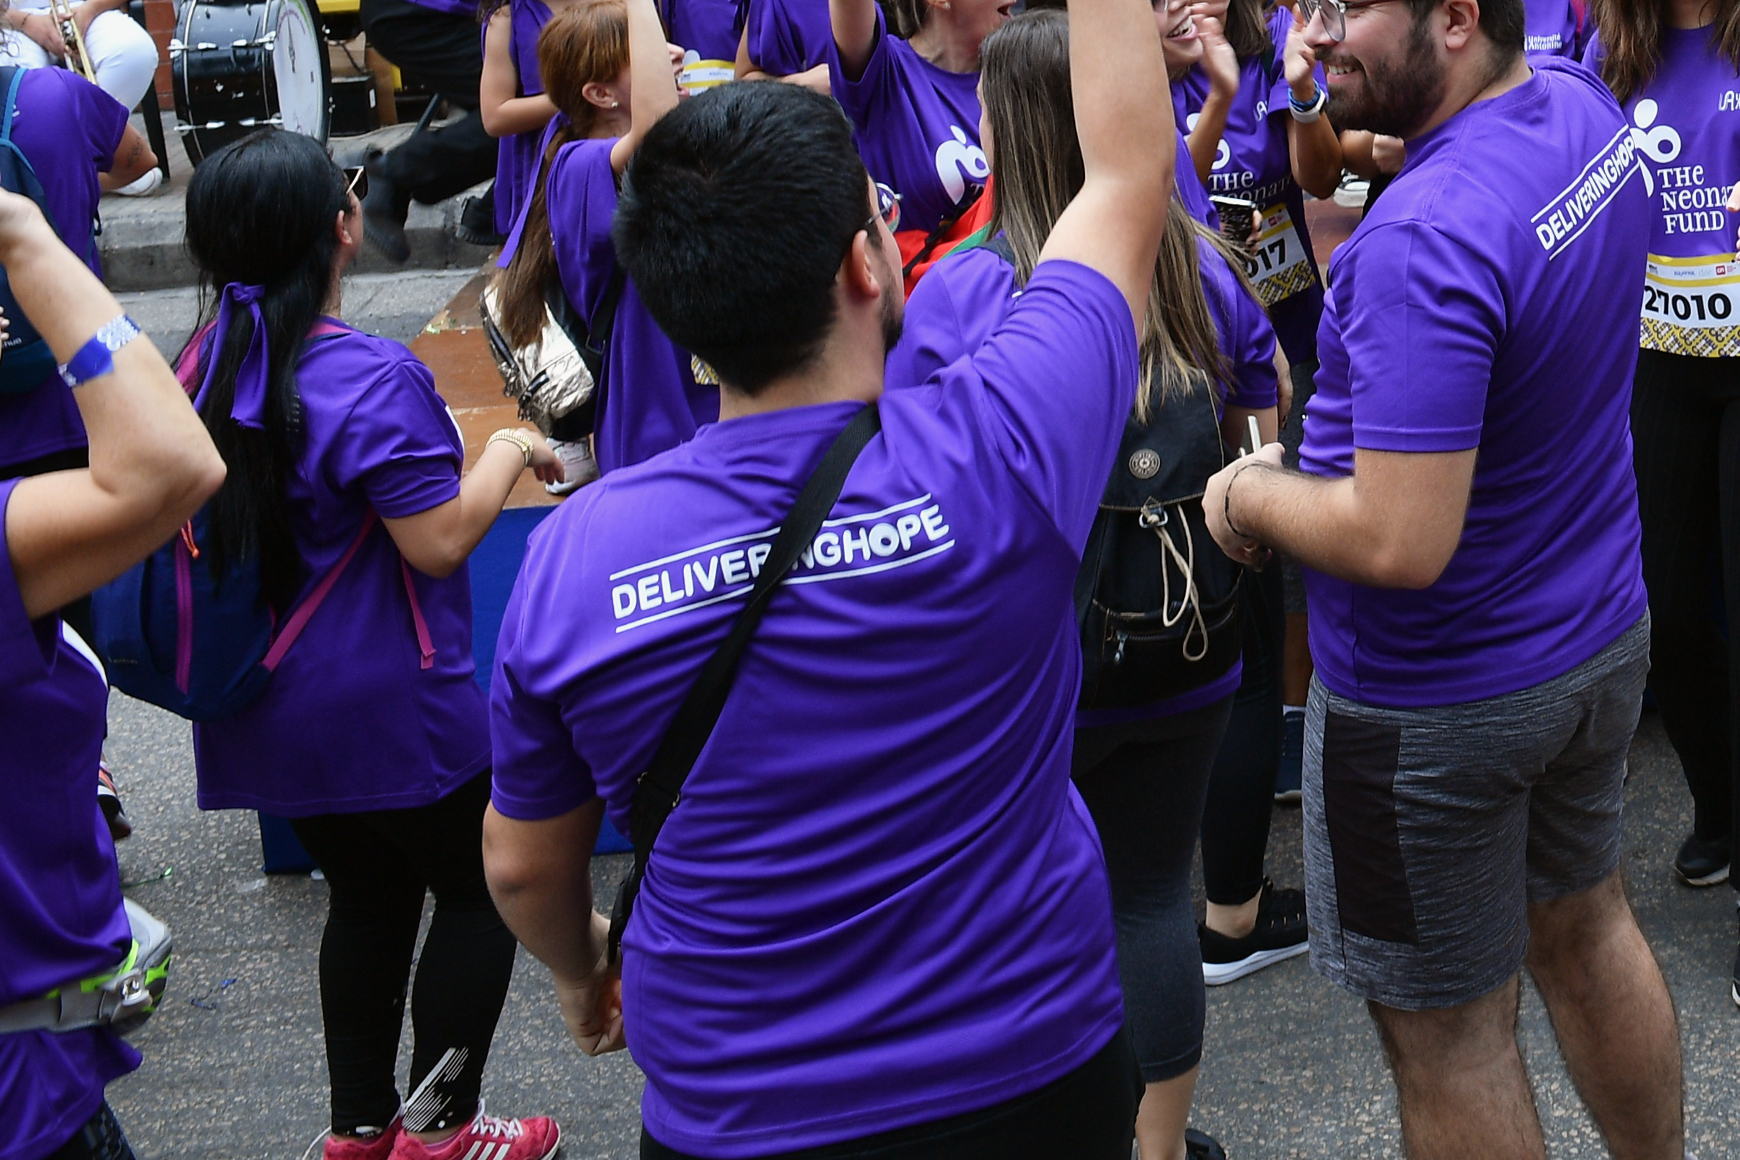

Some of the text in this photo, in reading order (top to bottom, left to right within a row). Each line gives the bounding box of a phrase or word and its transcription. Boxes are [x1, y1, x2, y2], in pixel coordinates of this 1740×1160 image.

[1535, 135, 1636, 251] DELIVERINGHOP
[1644, 285, 1732, 320] 27010
[611, 504, 950, 619] DELIVERNGHOPE
